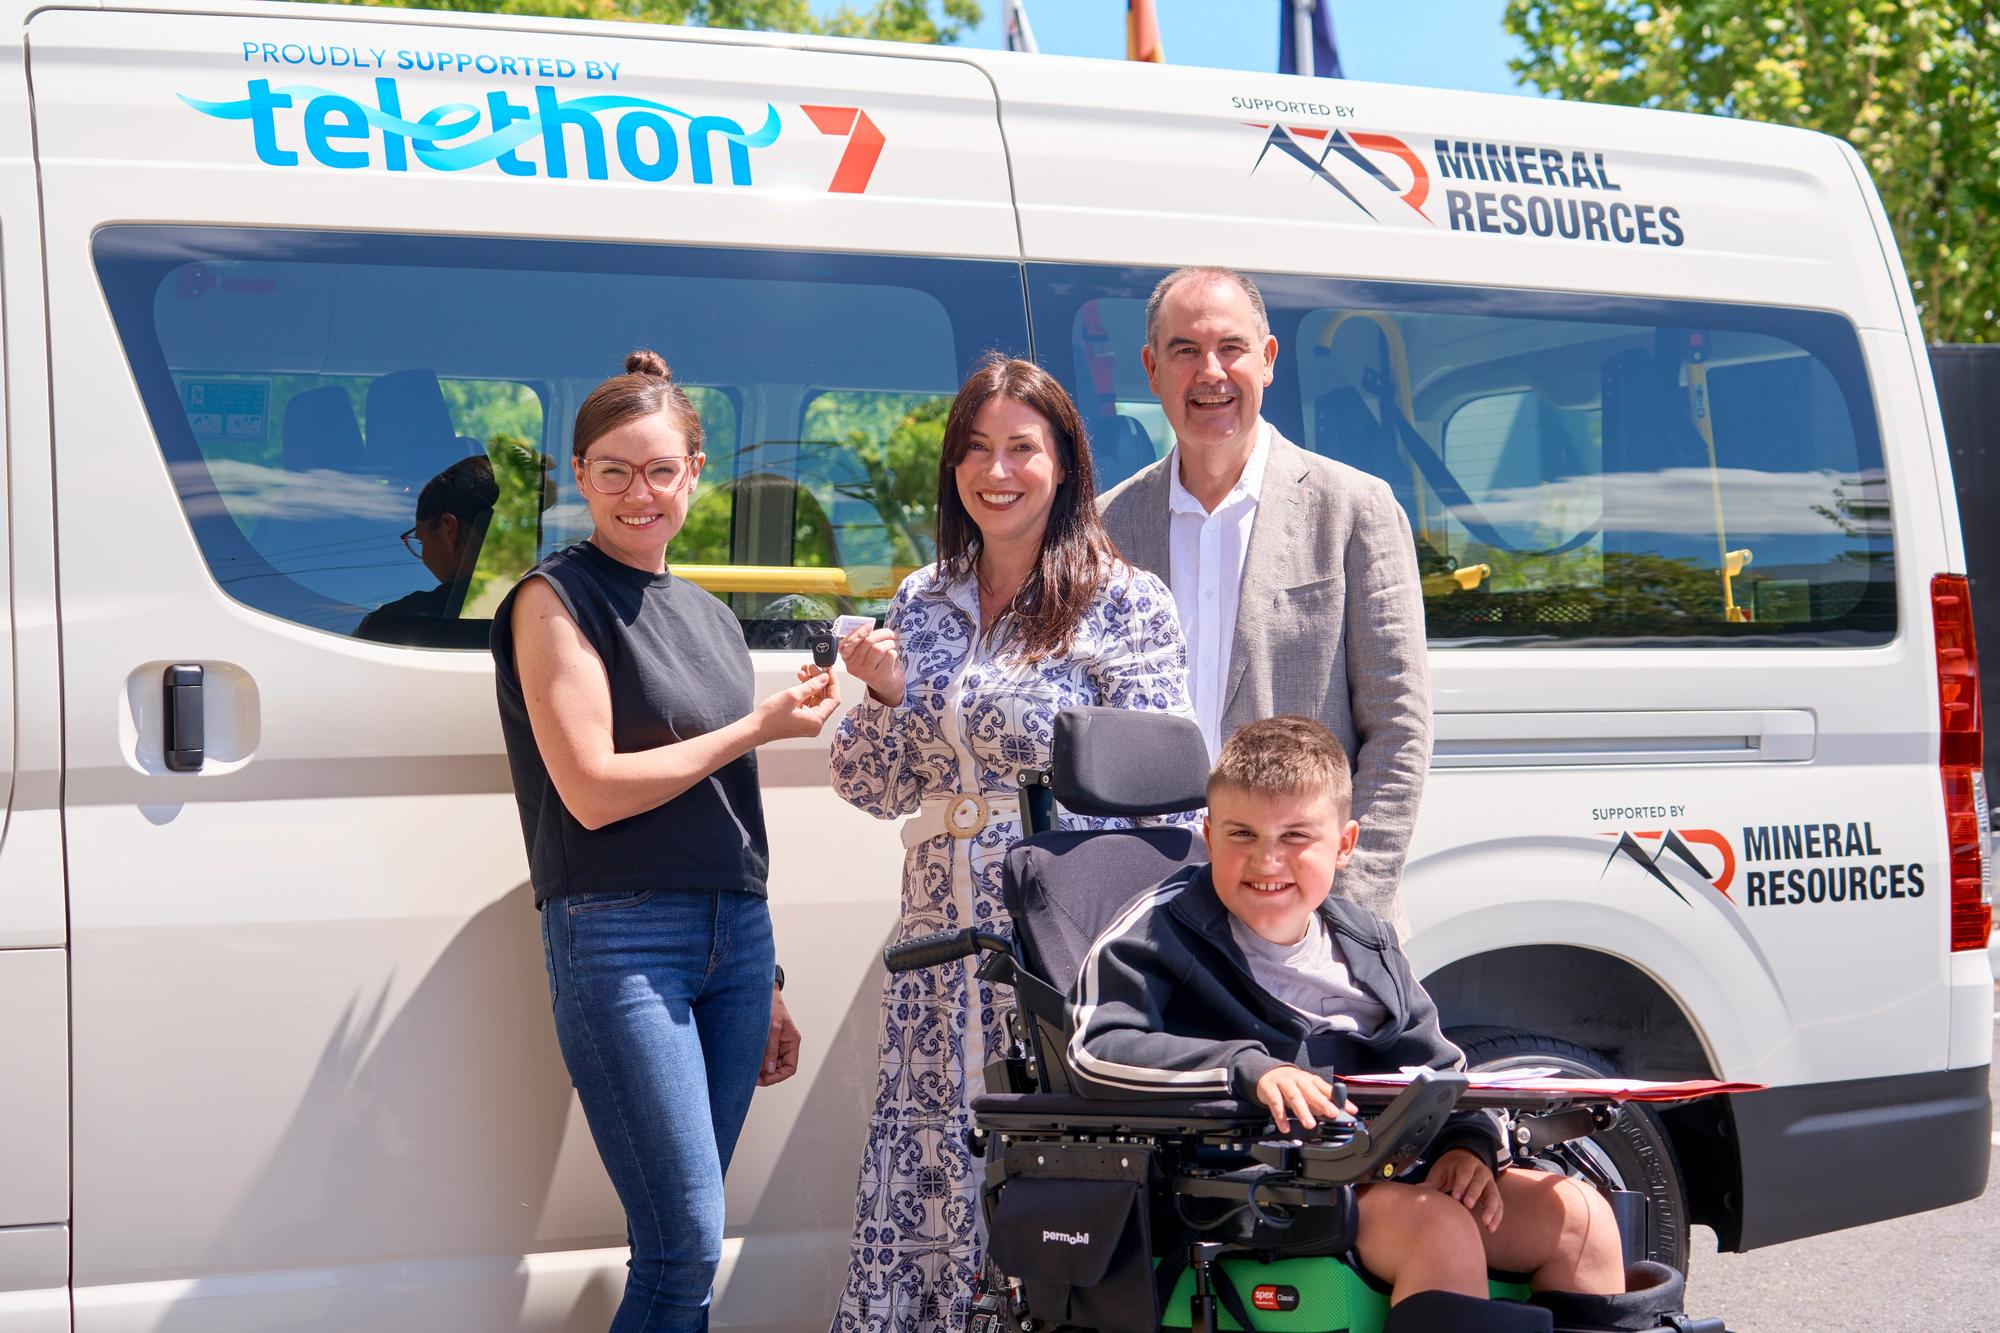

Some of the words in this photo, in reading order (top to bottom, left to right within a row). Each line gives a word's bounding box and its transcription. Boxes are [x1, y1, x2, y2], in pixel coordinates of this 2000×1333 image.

[243, 41, 386, 69] PROUDLY
[397, 50, 576, 79] SUPPORTED
[586, 61, 622, 81] BY
[1231, 96, 1330, 117] SUPPORTED
[1335, 105, 1356, 119] BY
[248, 77, 752, 186] telethon
[1434, 139, 1621, 192] MINERAL
[1445, 189, 1685, 247] RESOURCES
[1592, 806, 1667, 821] SUPPORTED
[1671, 805, 1686, 818] BY
[1742, 821, 1882, 862] MINERAL
[1747, 863, 1925, 907] RESOURCES
[1042, 1230, 1090, 1245] permobil
[1255, 1290, 1274, 1301] spex
